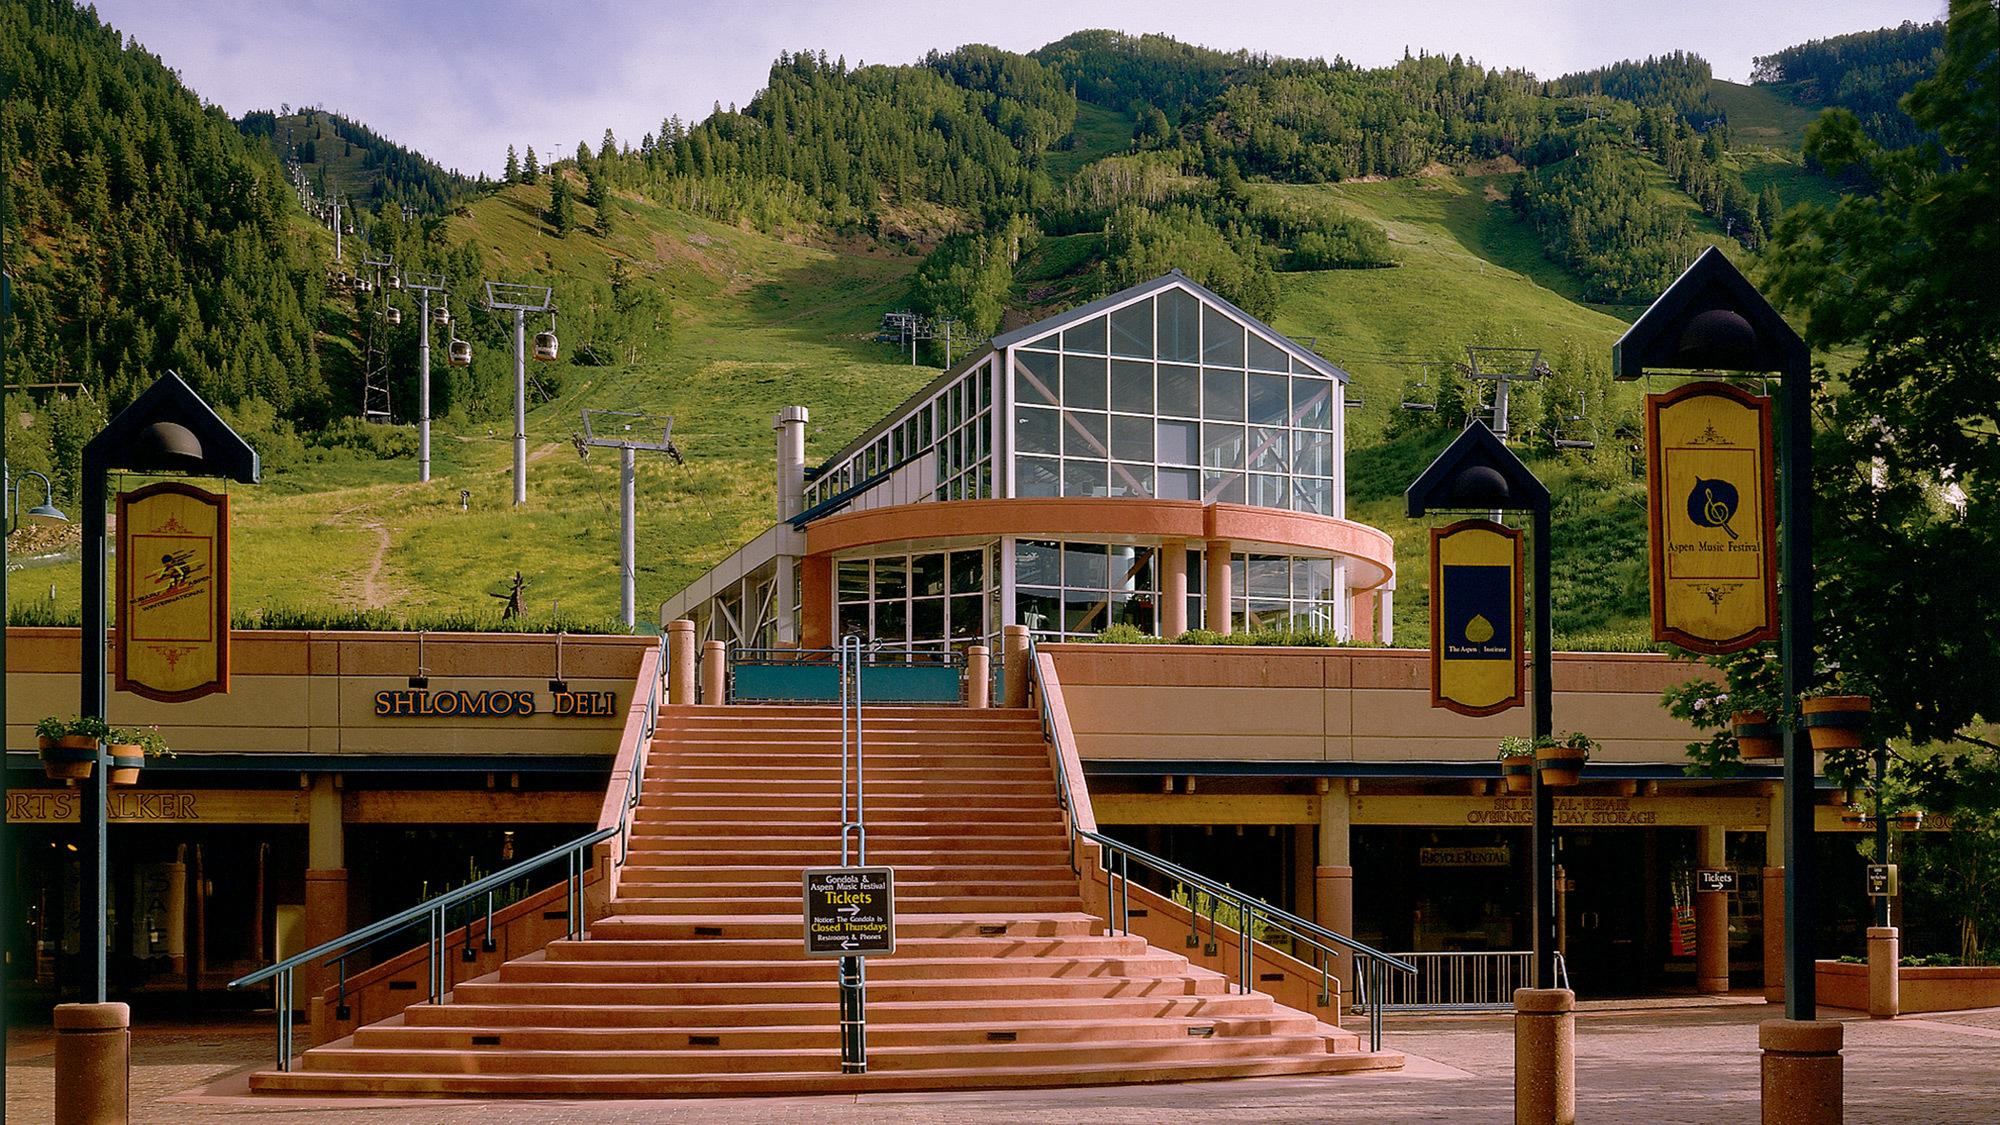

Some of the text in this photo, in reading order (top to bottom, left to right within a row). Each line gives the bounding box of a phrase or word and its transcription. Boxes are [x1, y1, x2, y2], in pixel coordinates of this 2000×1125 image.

[1668, 541, 1760, 554] Aspen Music Festival
[142, 588, 205, 612] WINTERNATIONAL
[1449, 645, 1507, 654] The Aspen Institute
[375, 691, 616, 717] SHLOMO'S DELI
[7, 793, 199, 819] RTSLKER
[1493, 799, 1631, 811] SKI RTAL-REPAIR
[1467, 811, 1657, 824] OVERNIG-DAY STORAGE
[825, 875, 869, 884] Gondola &
[1703, 872, 1733, 883] Tickets
[810, 883, 834, 892] Aspen
[860, 882, 886, 890] Festival
[824, 891, 872, 904] Tickets
[811, 923, 888, 933] Closed Thursdays
